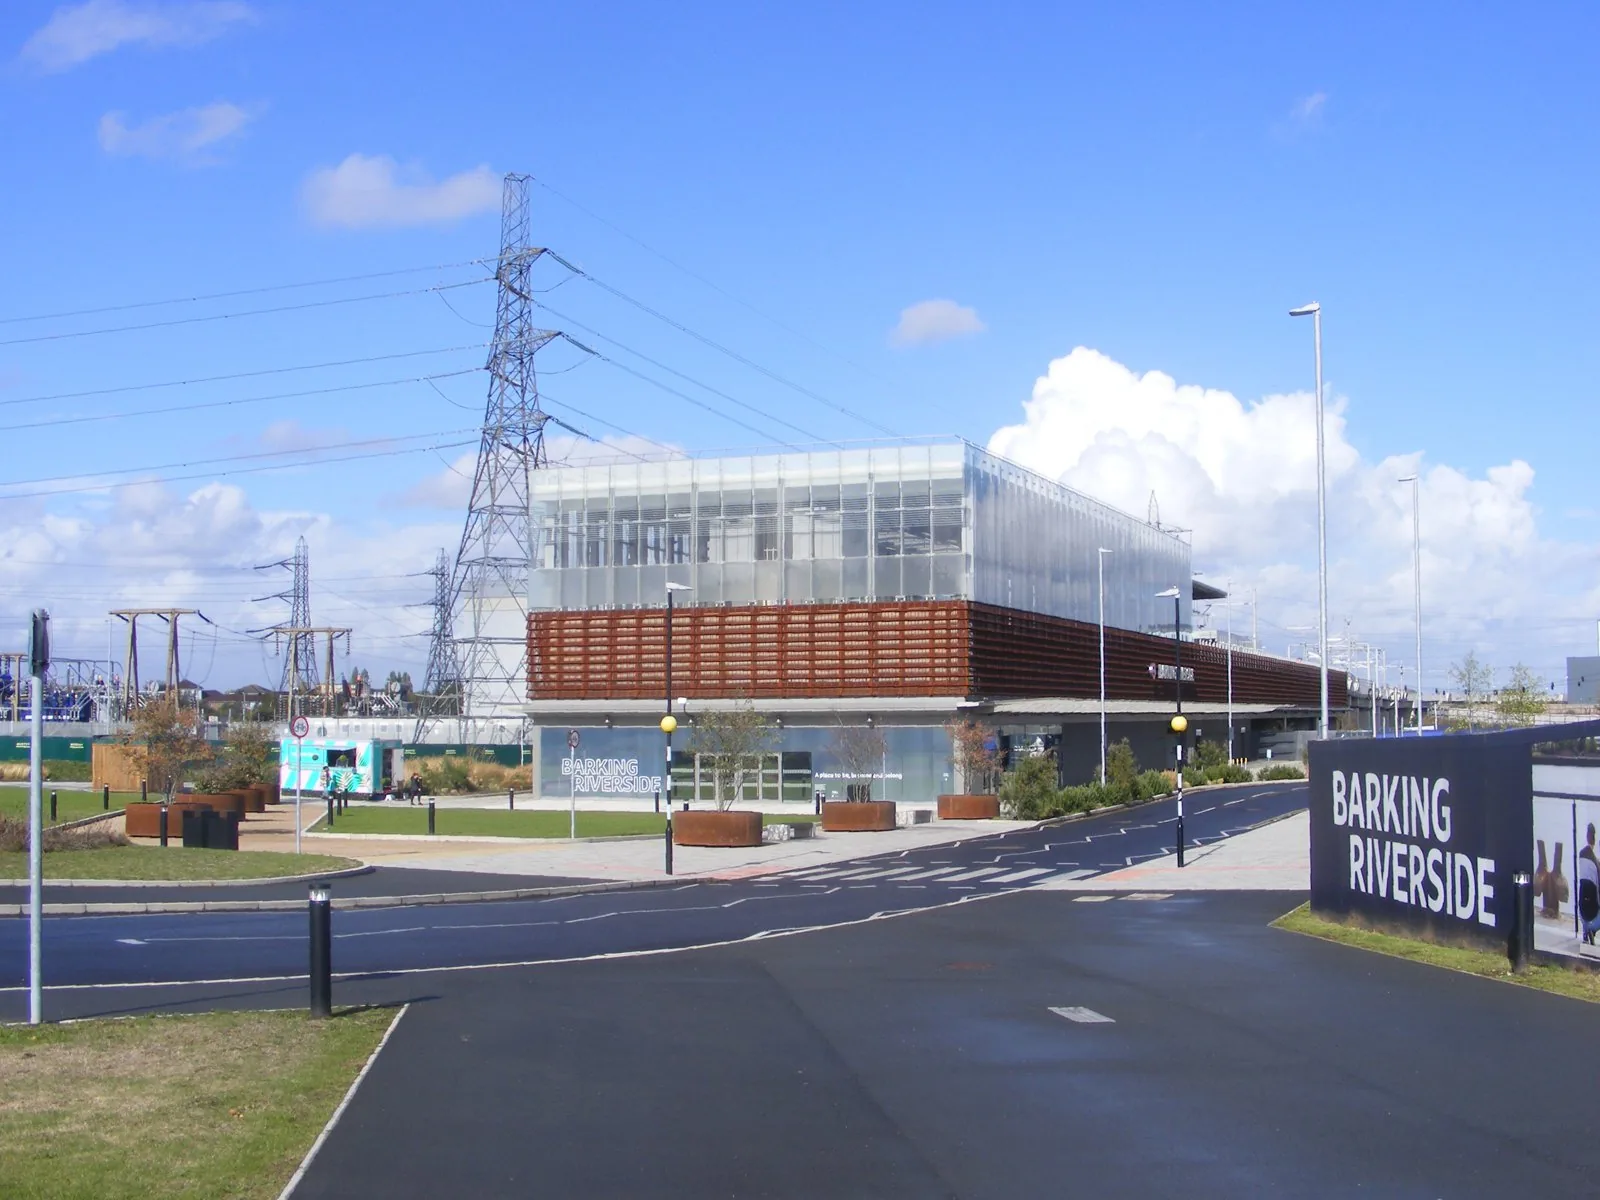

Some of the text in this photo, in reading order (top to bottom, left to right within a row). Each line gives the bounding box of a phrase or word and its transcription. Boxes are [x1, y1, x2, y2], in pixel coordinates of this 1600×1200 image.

[561, 758, 638, 776] BARKING
[574, 775, 662, 793] RIVERSIDE
[1333, 770, 1451, 843] BARKING
[1350, 834, 1496, 927] RIVERSIDE
